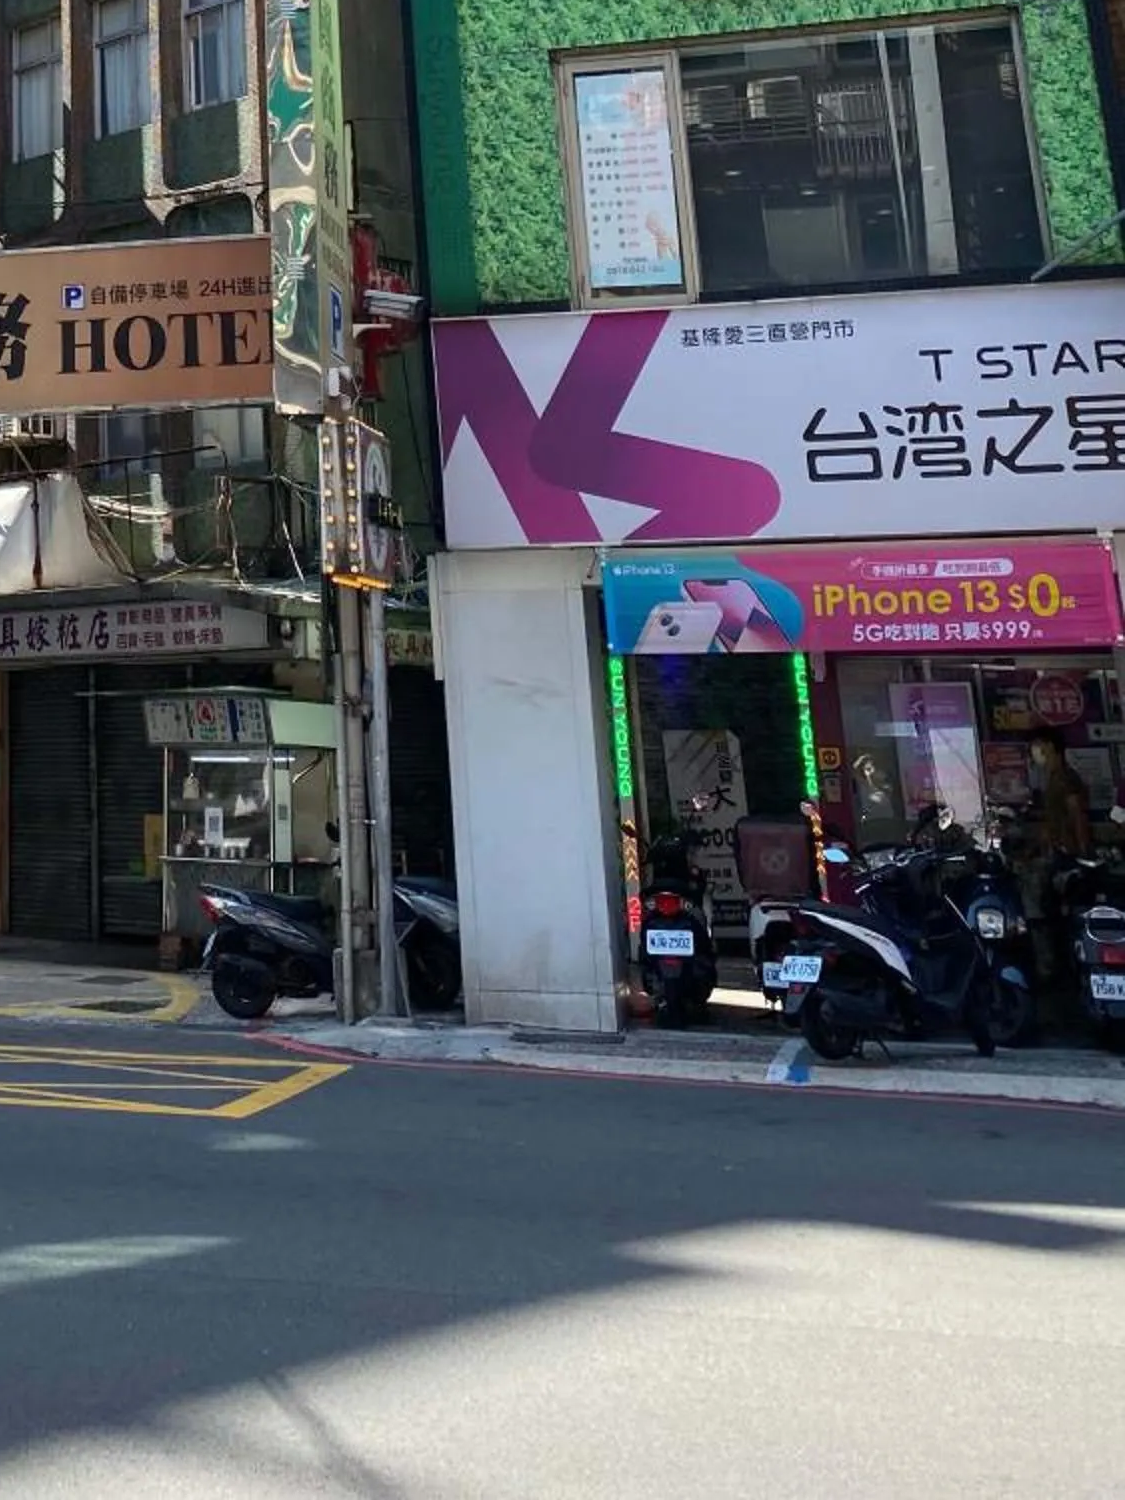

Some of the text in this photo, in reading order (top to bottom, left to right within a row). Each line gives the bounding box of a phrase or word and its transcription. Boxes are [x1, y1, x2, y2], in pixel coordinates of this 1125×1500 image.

[90, 280, 190, 305] 自備停車場
[56, 309, 273, 375] HOTE
[680, 319, 855, 348] 基隆愛三直營門市
[918, 339, 1125, 382] T STAR
[813, 585, 952, 617] iPhone
[958, 581, 1001, 614] 13
